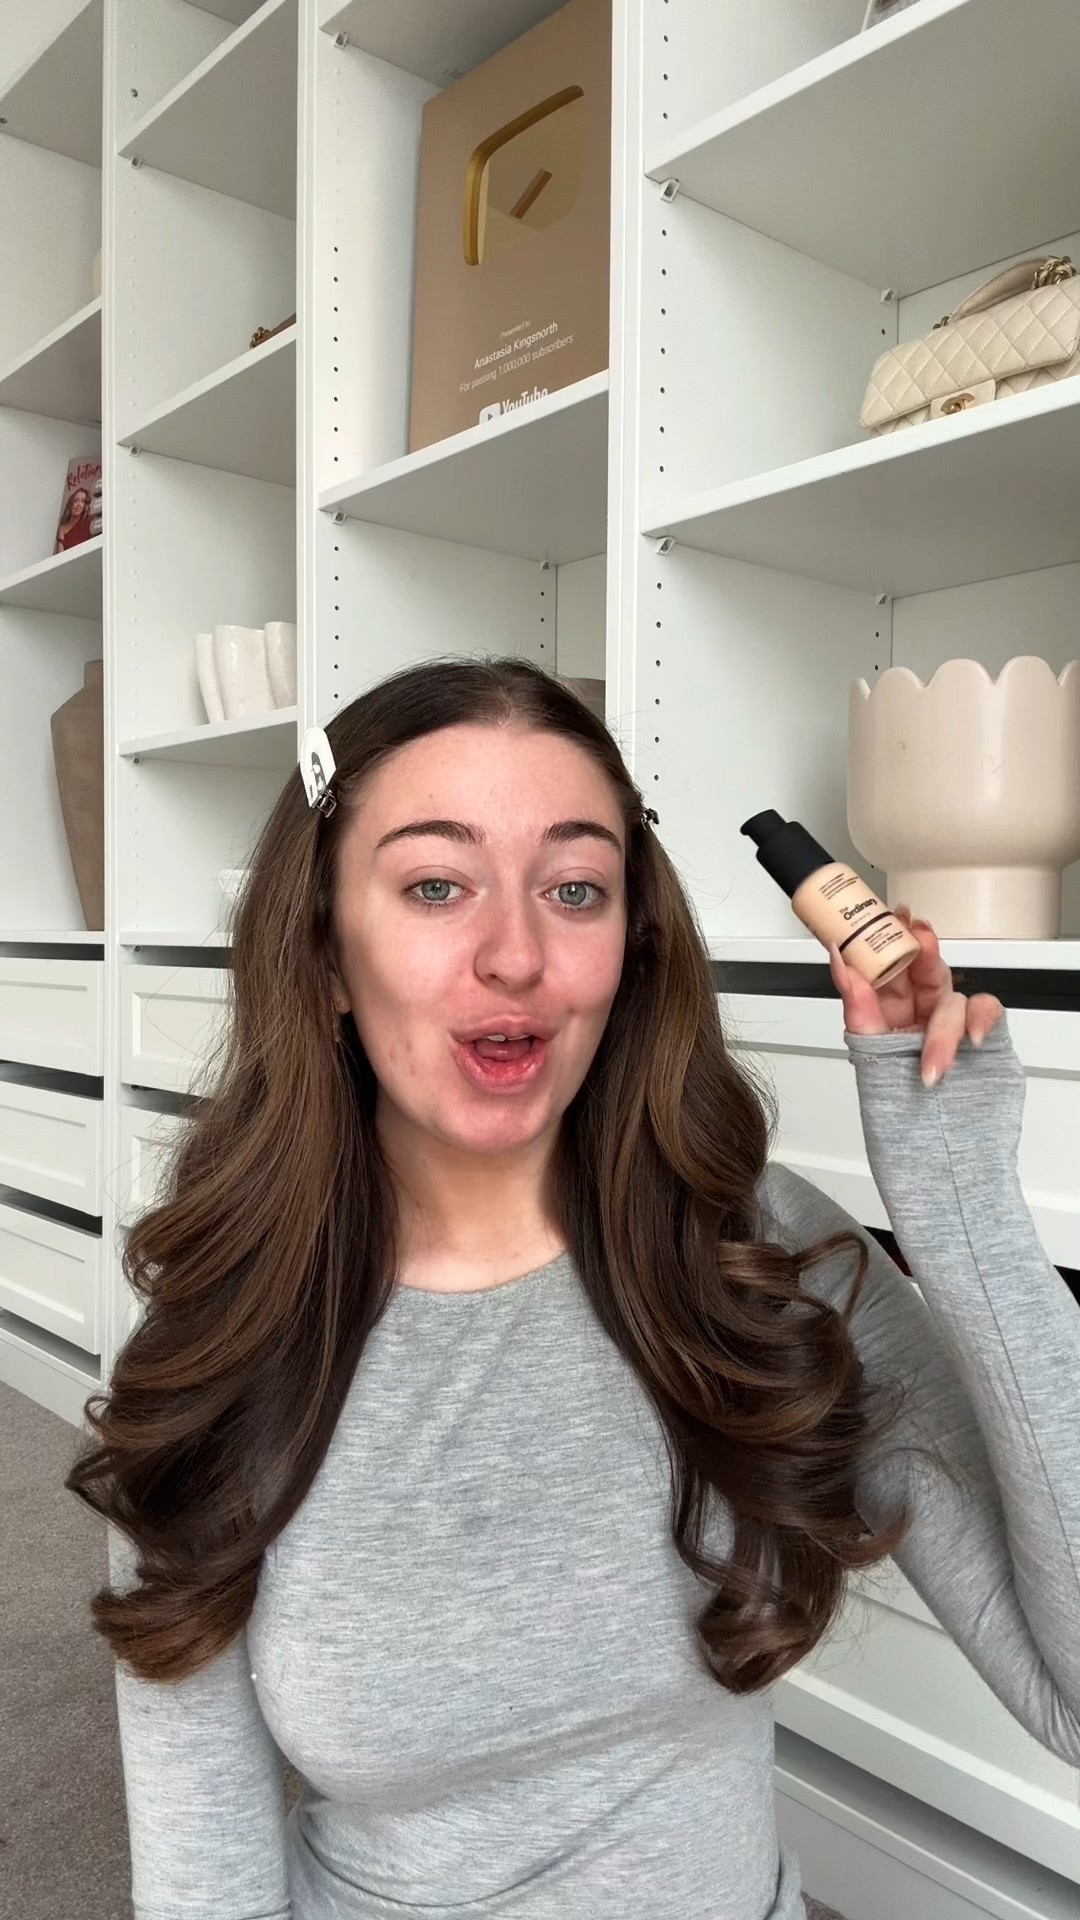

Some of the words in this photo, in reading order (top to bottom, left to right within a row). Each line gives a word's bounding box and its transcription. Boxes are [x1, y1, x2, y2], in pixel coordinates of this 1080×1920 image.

[459, 381, 470, 393] For
[471, 370, 497, 390] passing
[531, 334, 574, 360] subscribers
[474, 344, 512, 370] Anastasia
[513, 322, 558, 349] Kingsnorth
